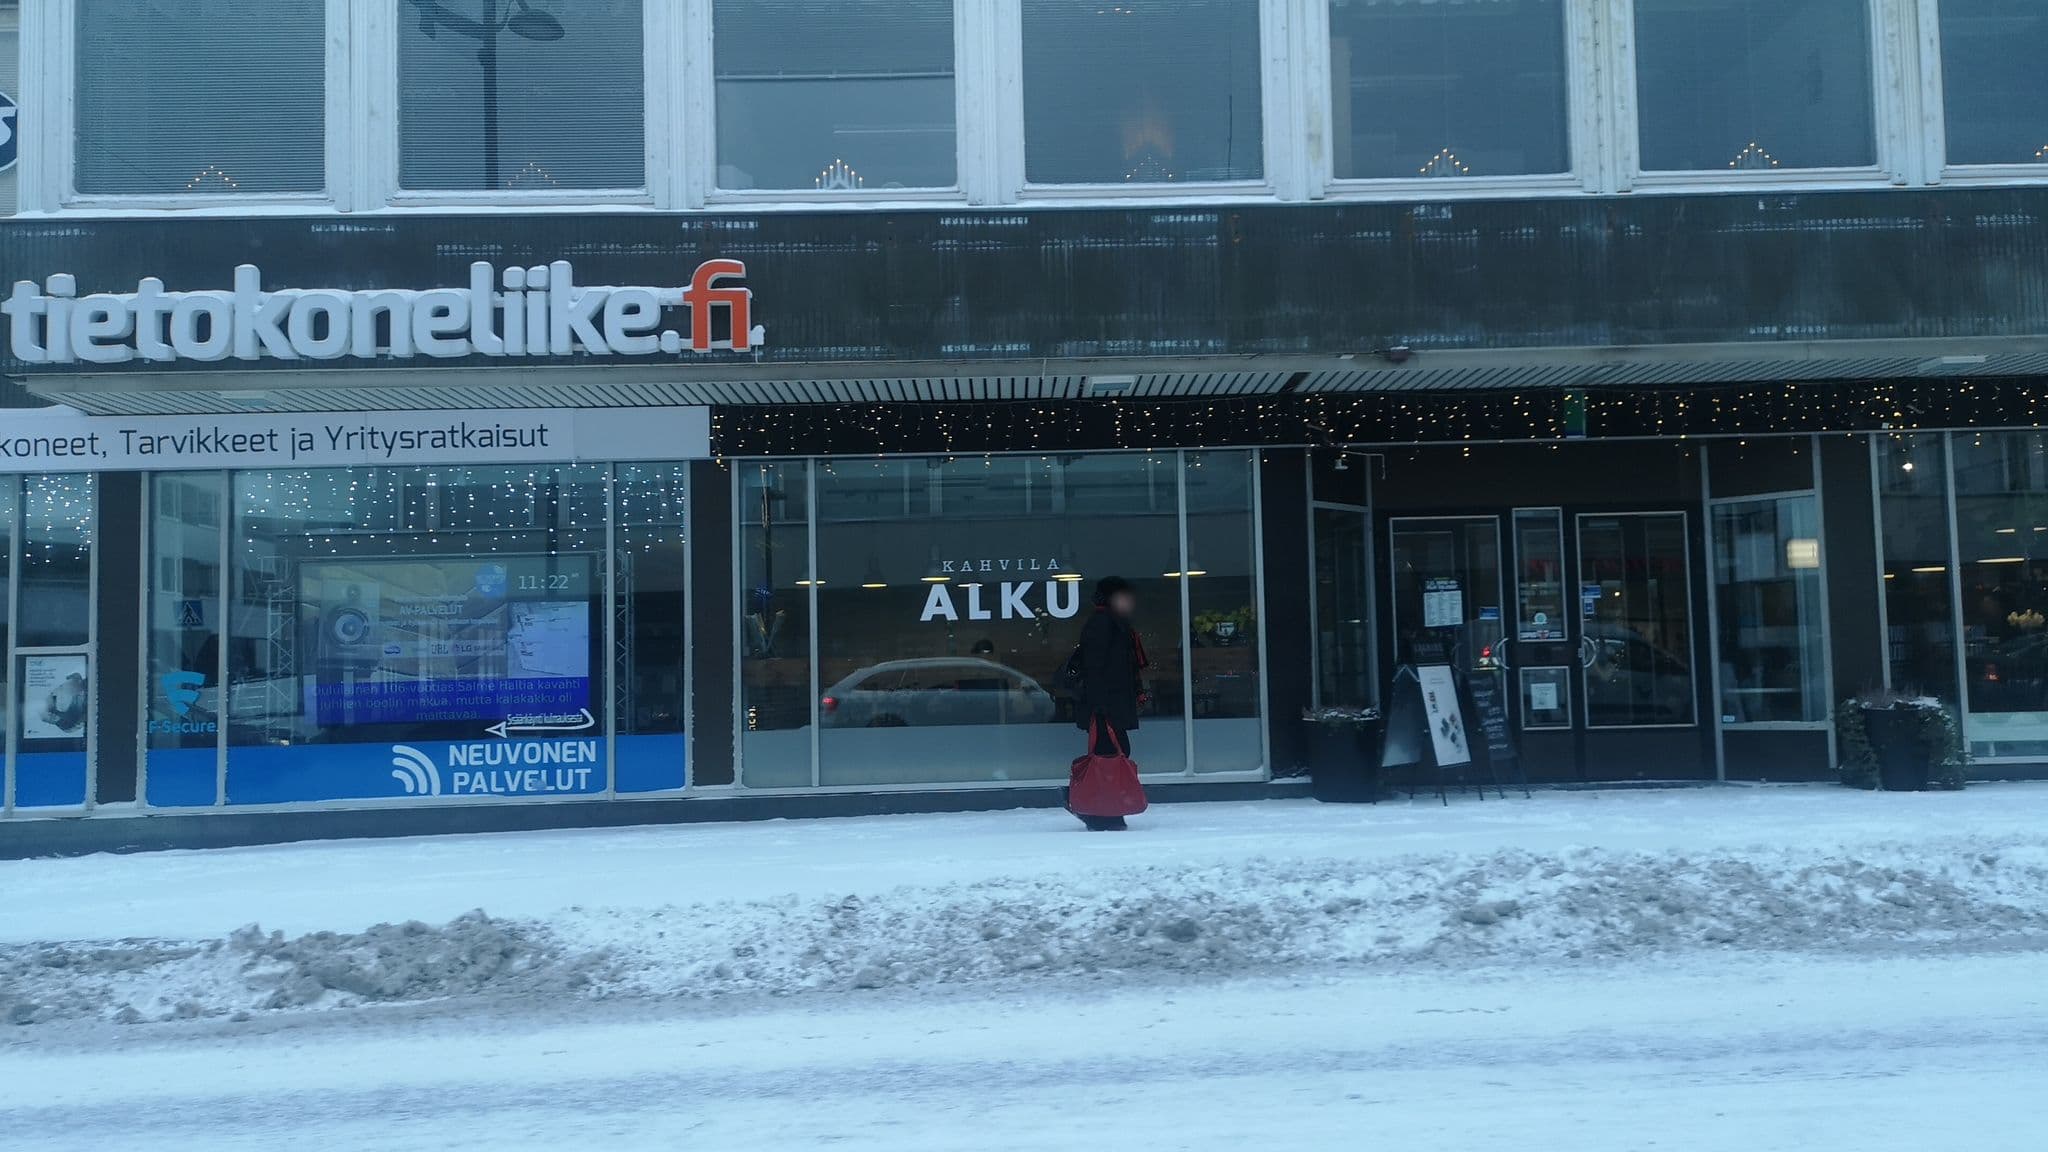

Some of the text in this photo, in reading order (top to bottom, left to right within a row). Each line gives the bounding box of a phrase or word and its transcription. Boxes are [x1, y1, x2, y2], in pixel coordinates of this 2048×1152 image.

[1, 257, 752, 364] tietokoneliike.fi
[120, 428, 279, 456] Tarvikkeet
[289, 431, 315, 461] ja
[325, 423, 550, 458] Yritysratkaisut
[942, 558, 1061, 572] KAHVILA
[518, 575, 569, 590] 11:22
[920, 580, 1081, 622] ALKU
[497, 692, 555, 704] kalakakku
[448, 741, 597, 766] NEUVONEN
[452, 768, 592, 793] PALVELUT
